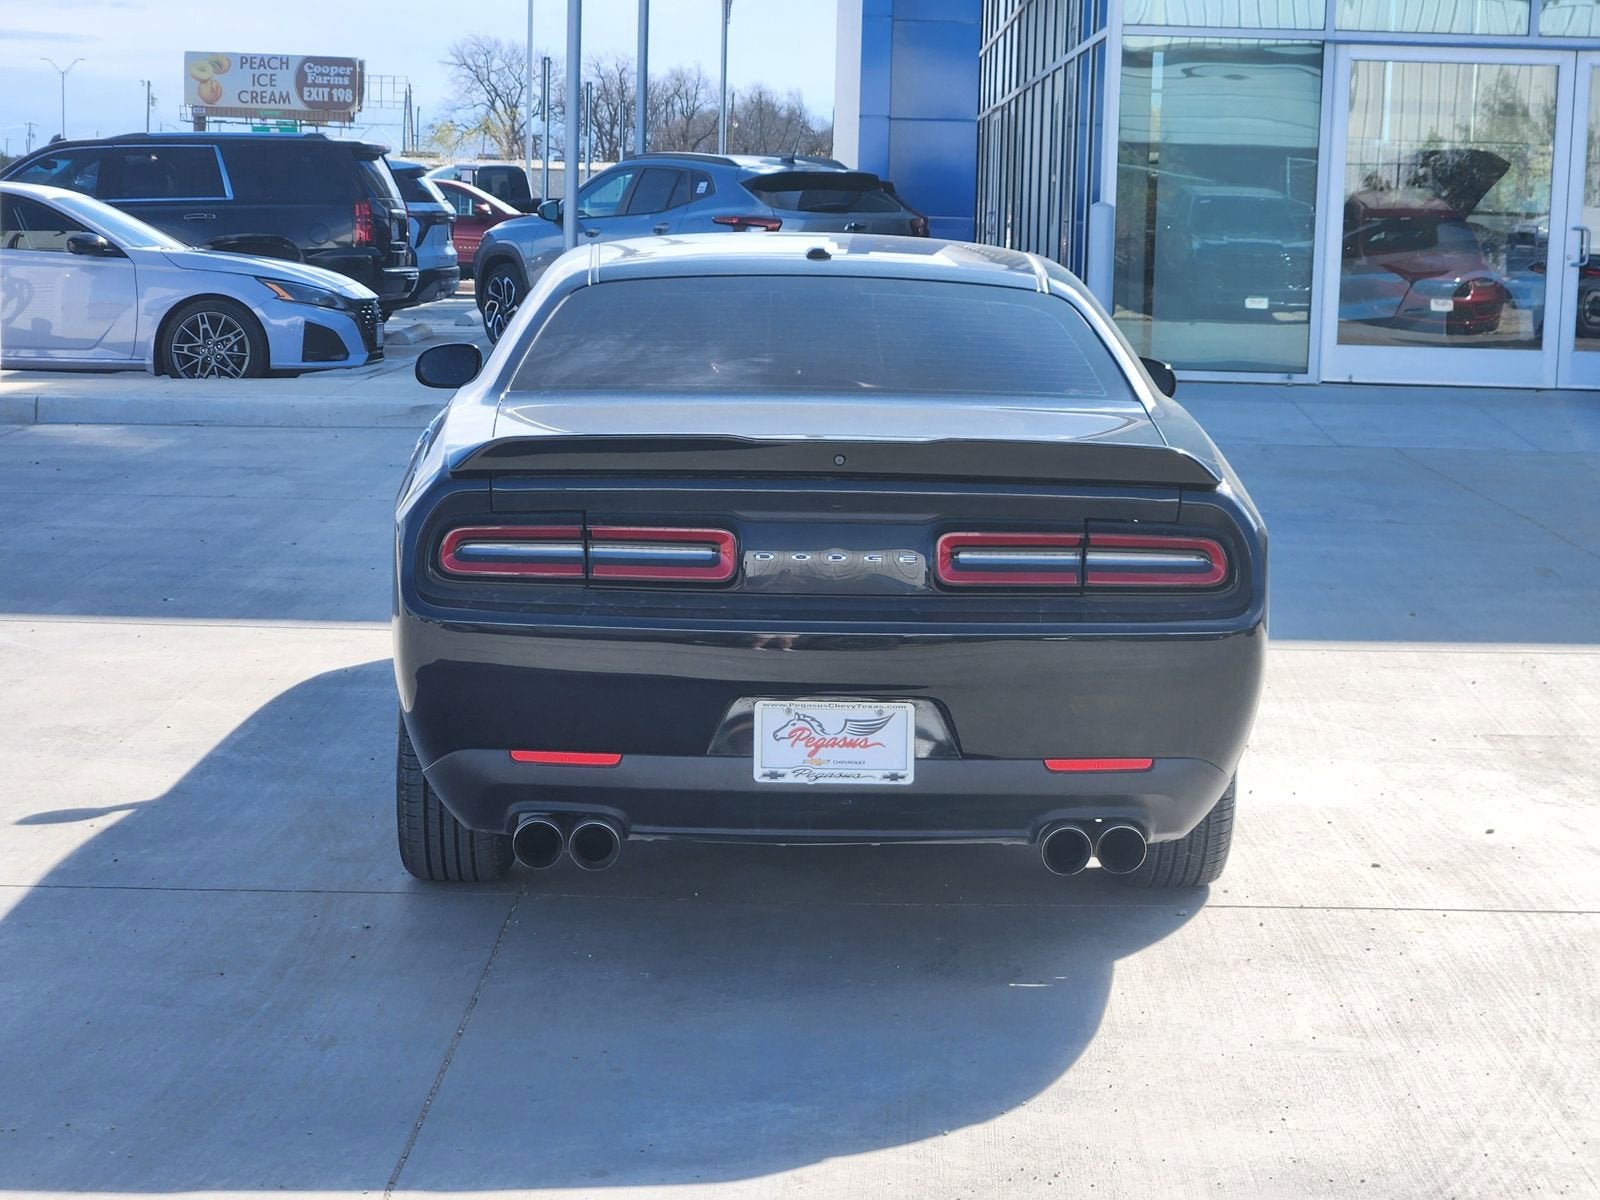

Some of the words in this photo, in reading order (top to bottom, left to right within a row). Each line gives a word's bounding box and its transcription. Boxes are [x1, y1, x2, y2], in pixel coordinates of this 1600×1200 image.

[239, 56, 289, 71] PEACH
[303, 63, 353, 75] Cooper
[252, 74, 277, 87] ICE
[307, 74, 349, 85] Farms
[237, 90, 291, 105] CREAM
[303, 88, 330, 101] EXIT
[332, 89, 353, 102] 198
[755, 553, 918, 563] DODGE
[788, 727, 886, 758] Pegasus
[792, 768, 876, 782] Pegasus
